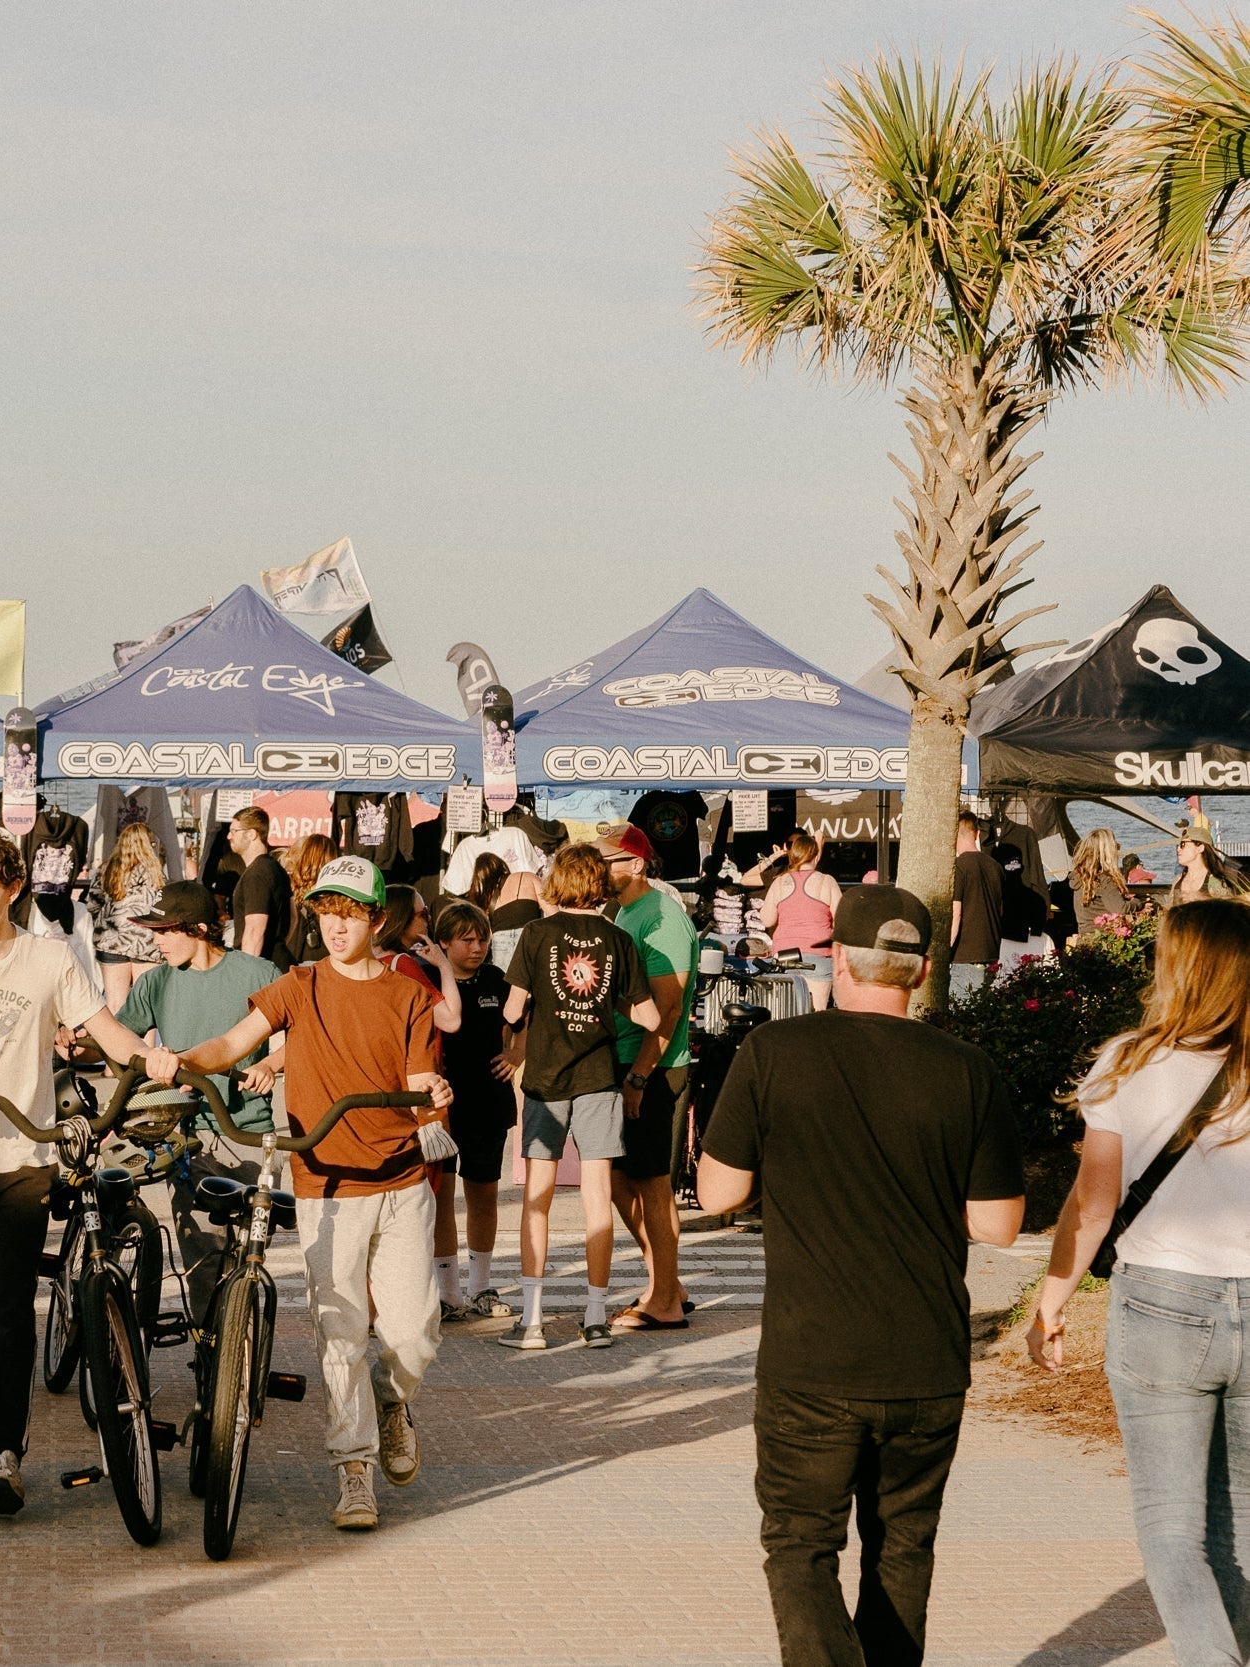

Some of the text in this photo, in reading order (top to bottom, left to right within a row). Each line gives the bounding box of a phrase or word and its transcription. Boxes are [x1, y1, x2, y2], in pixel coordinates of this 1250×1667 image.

[140, 662, 252, 697] Coastal
[262, 665, 365, 716] Edge
[602, 667, 840, 696] COASTAL
[700, 682, 841, 707] EDGE
[57, 740, 257, 780] COASTAL
[343, 742, 457, 781] EDGE
[542, 745, 740, 783] COASTAL
[825, 746, 967, 782] EDG
[1114, 751, 1250, 787] Skullca
[563, 932, 603, 948] VISSLA
[549, 945, 613, 1010] UNSOUND TUBE HOUNDS
[559, 1010, 594, 1023] STOKE
[567, 1023, 585, 1033] CO.
